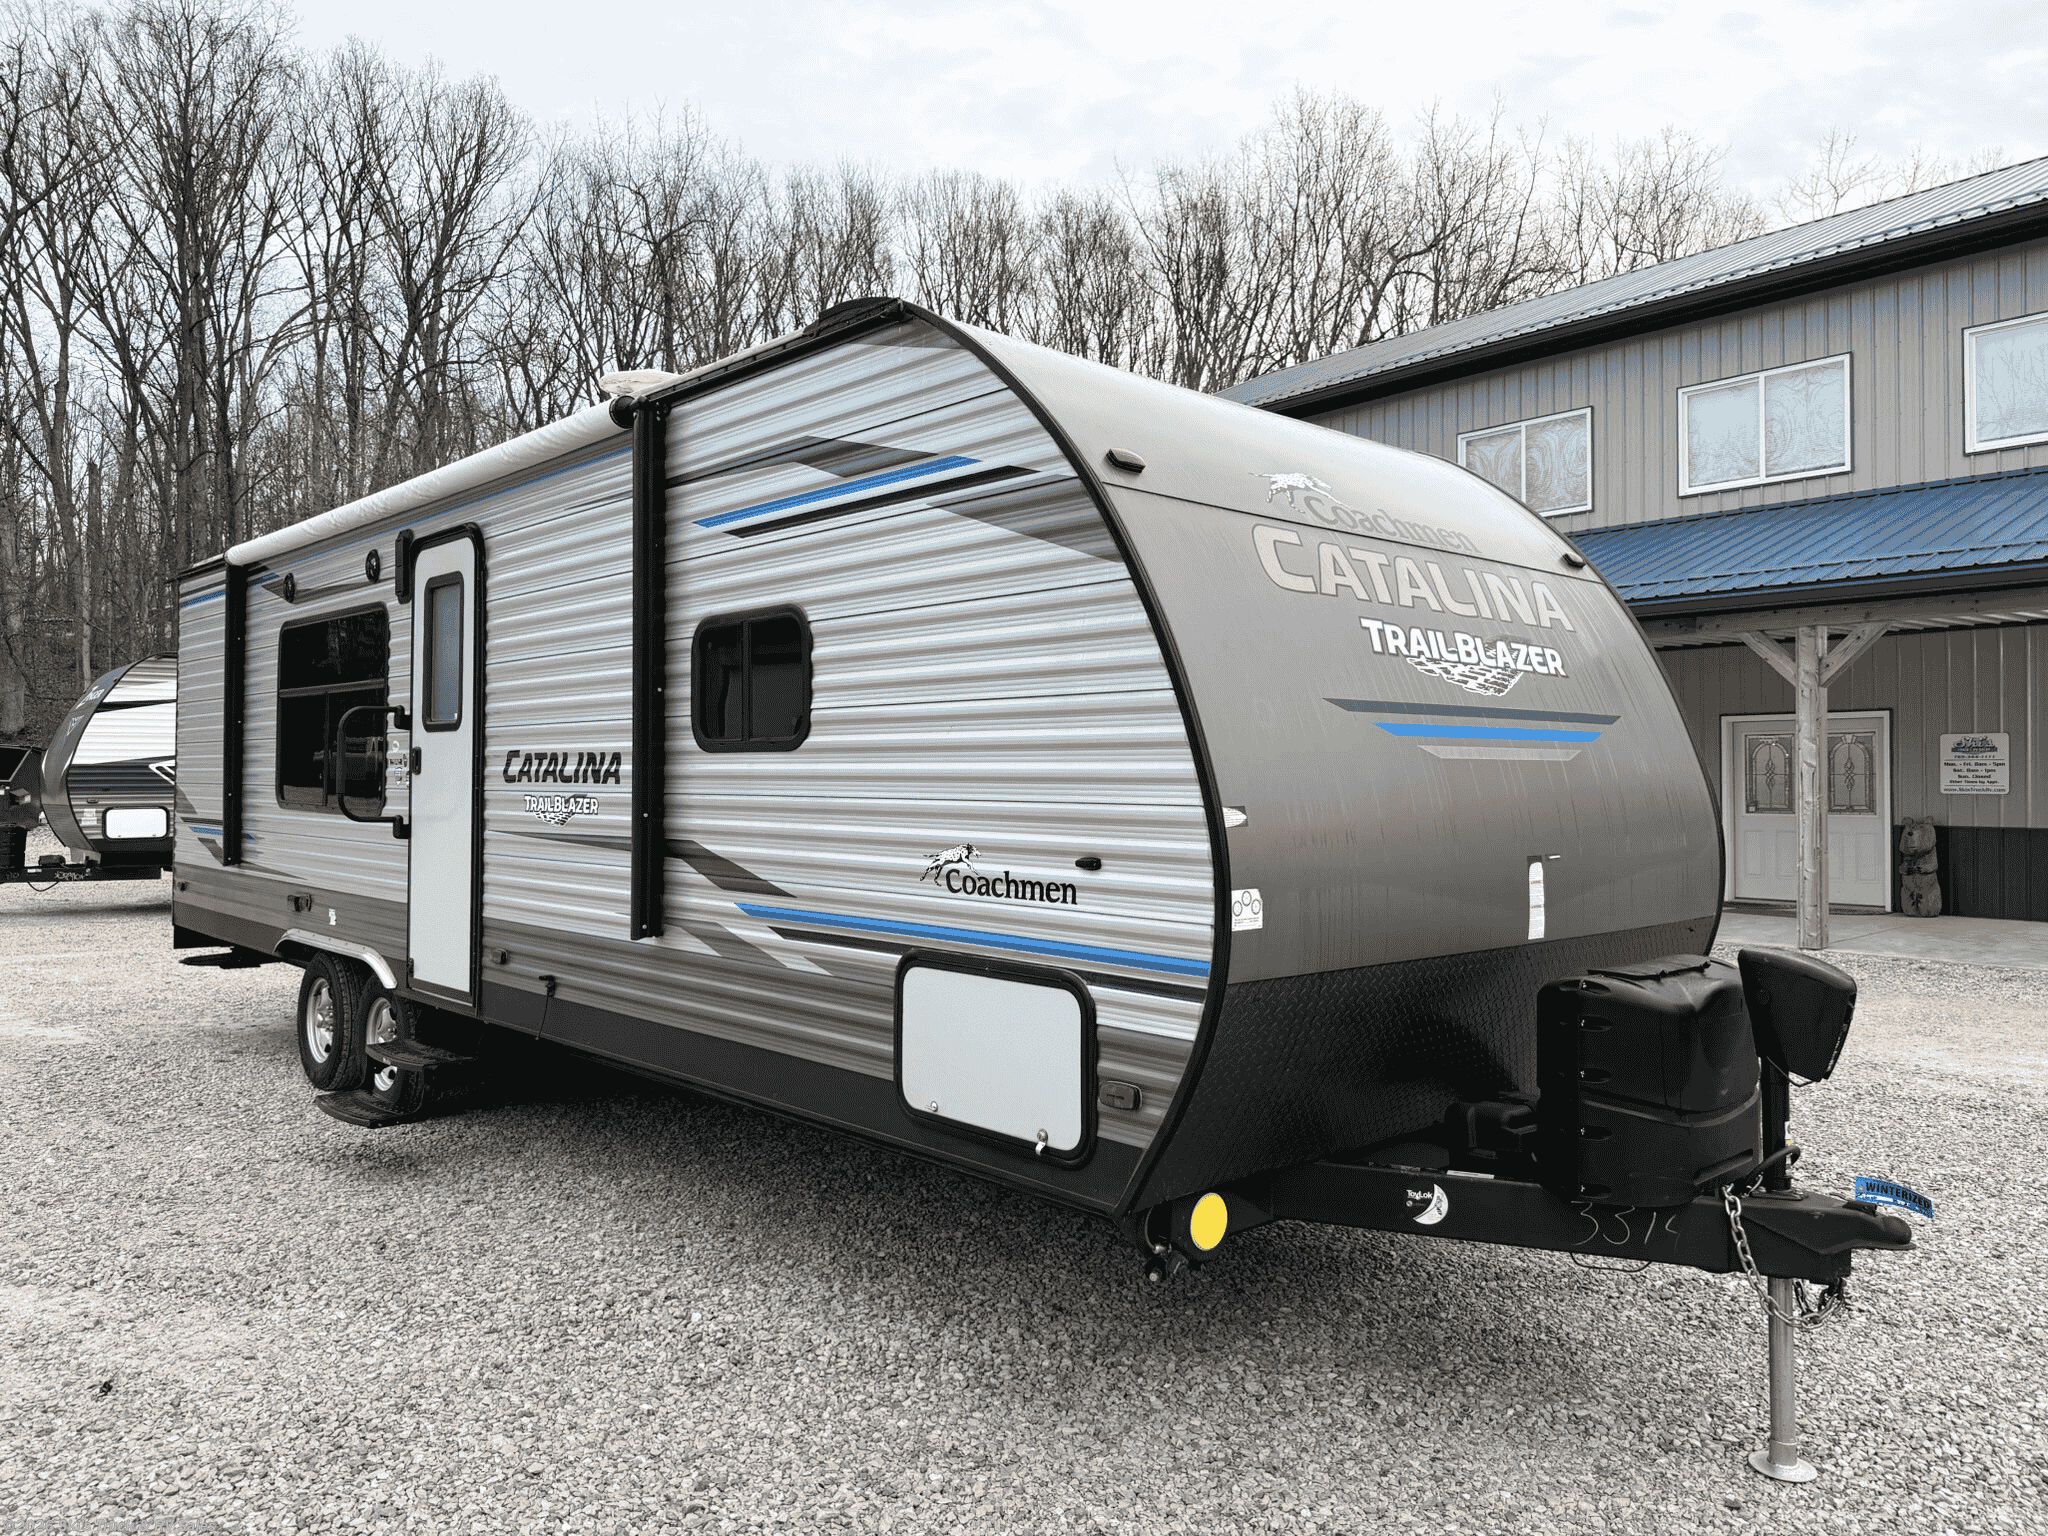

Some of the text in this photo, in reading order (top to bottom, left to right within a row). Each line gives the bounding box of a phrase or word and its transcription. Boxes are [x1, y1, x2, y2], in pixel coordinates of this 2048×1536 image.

[1304, 495, 1481, 553] Coachmen
[1252, 523, 1576, 632] CATALINA
[1359, 616, 1569, 678] TRAILBLAZER
[503, 750, 622, 784] CATALINA
[524, 794, 599, 815] TRAILBLAZER
[945, 868, 1078, 905] Coachmen
[1866, 1181, 1931, 1209] WINTERIZED
